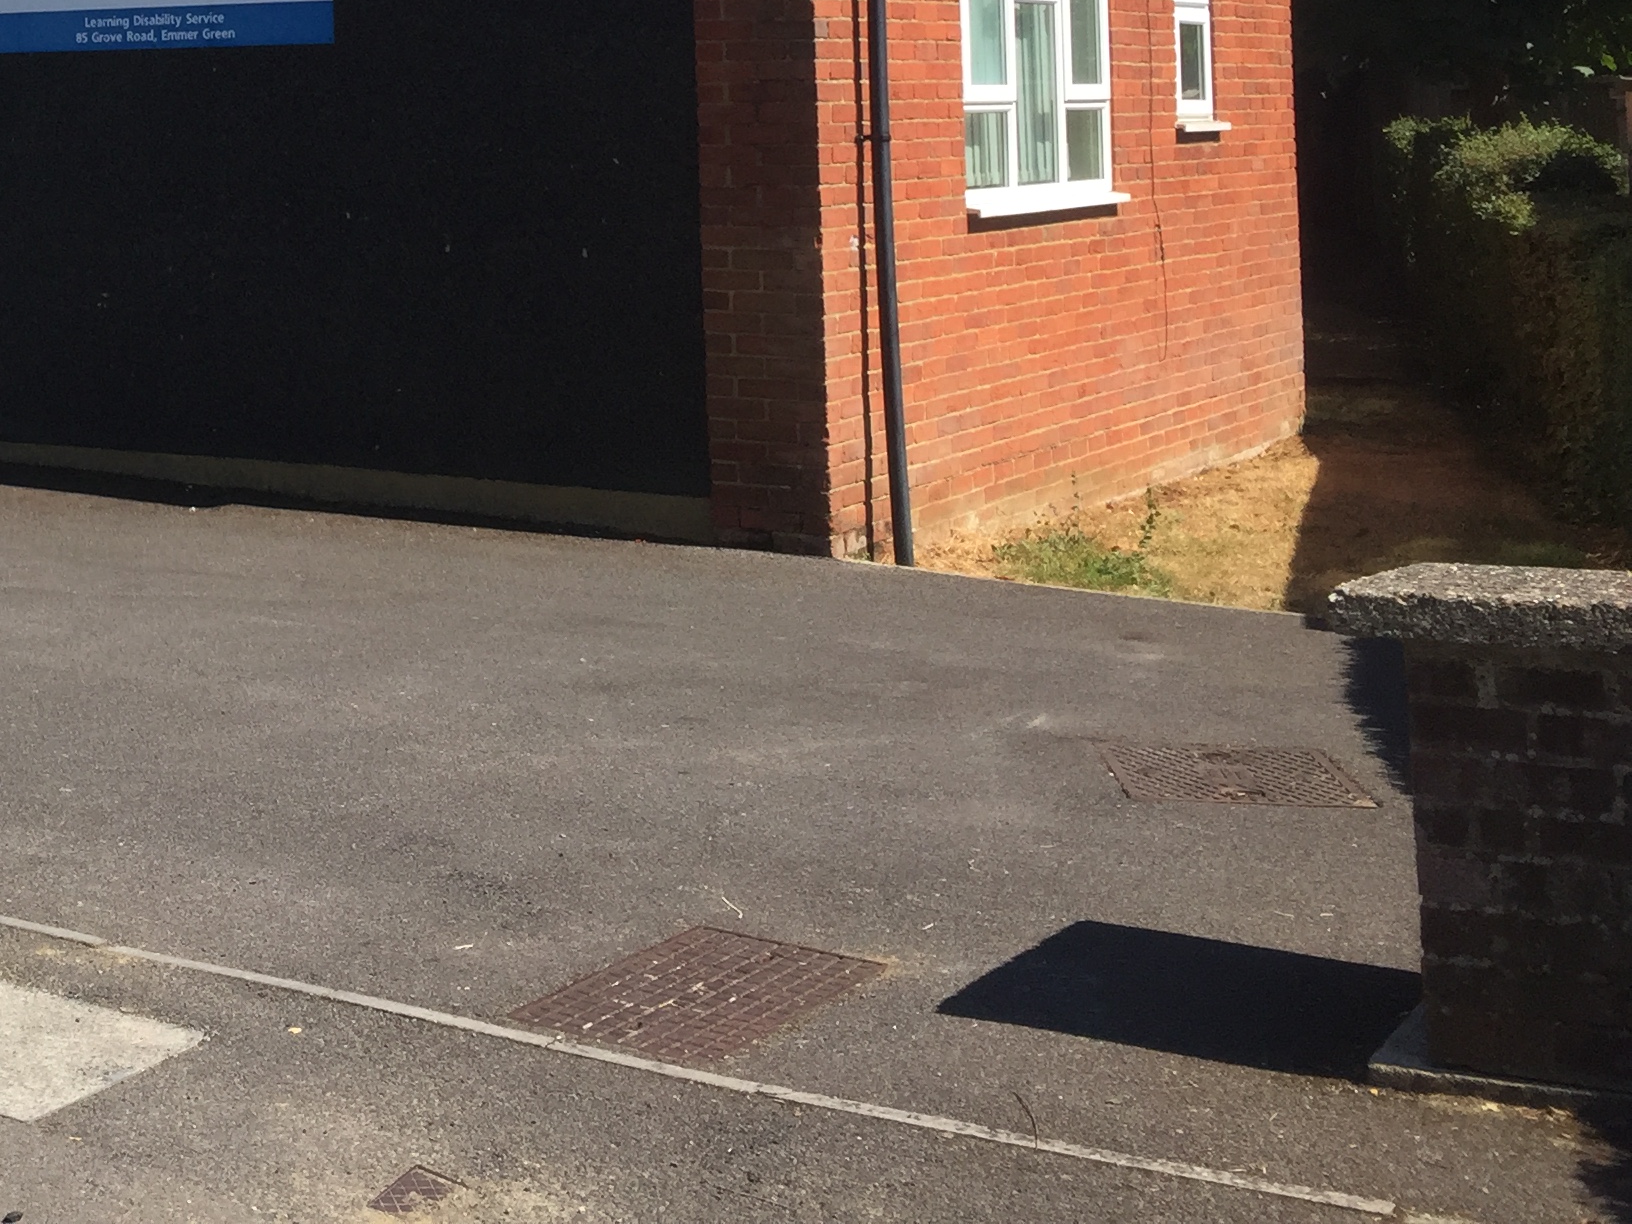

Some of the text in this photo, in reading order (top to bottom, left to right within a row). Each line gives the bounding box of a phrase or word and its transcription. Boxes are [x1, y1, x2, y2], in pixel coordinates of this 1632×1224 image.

[84, 11, 225, 29] Learning Disability Service
[75, 28, 236, 44] 85 Grove Road, Emmer Green
